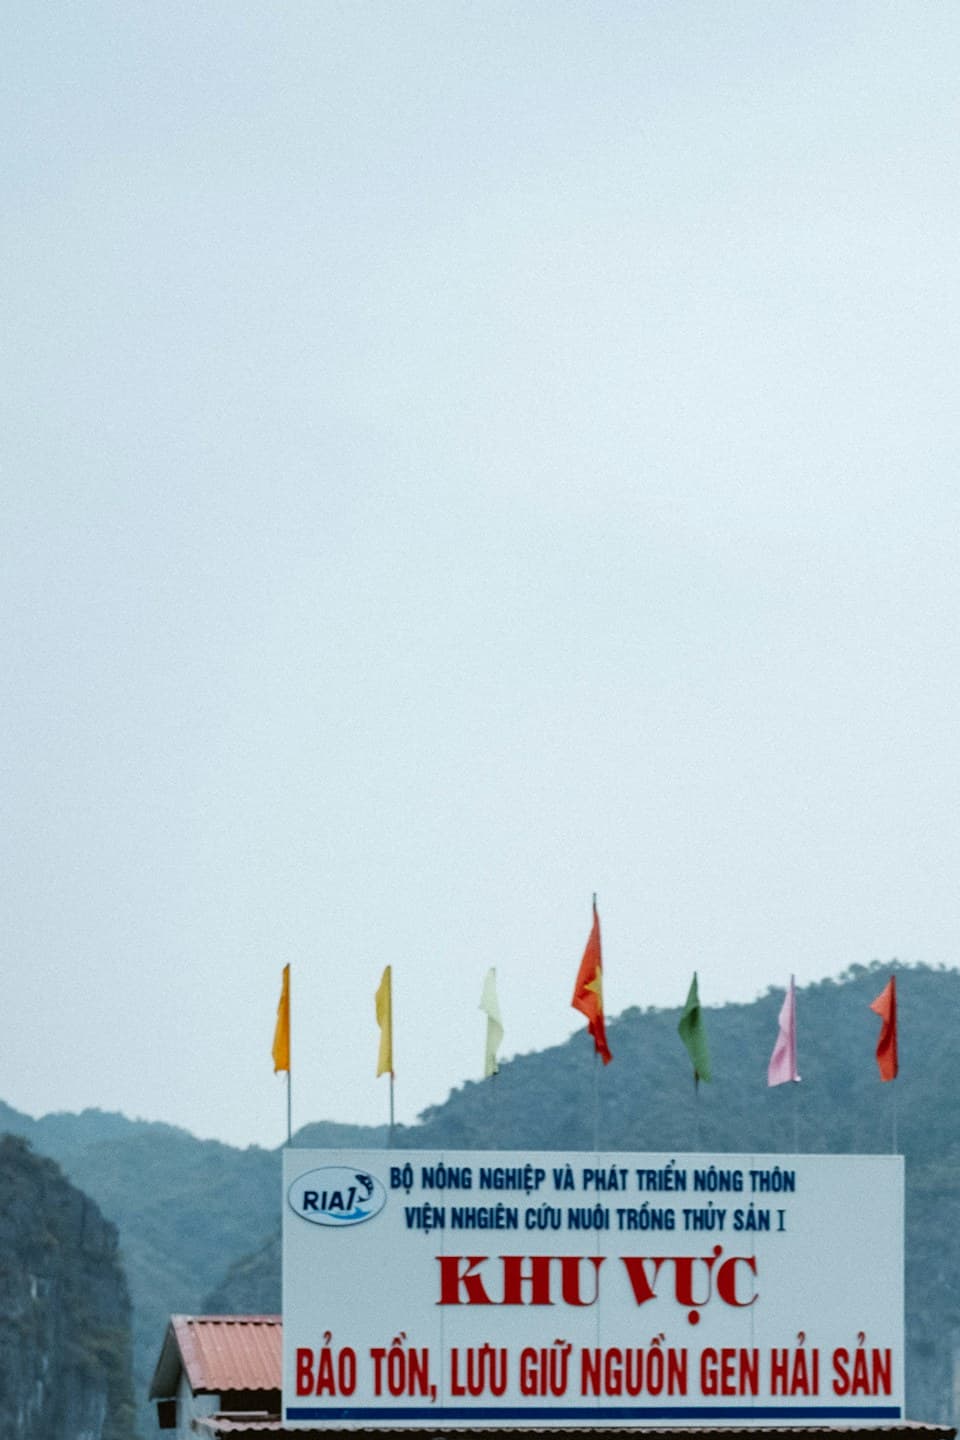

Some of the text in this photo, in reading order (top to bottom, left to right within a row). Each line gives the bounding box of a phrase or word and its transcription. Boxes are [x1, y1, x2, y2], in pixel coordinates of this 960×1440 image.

[390, 1159, 795, 1195] BỘ NÔNG NGHIỆP VÀ PHÁT TRIỂN NÔNG THÔN
[303, 1187, 357, 1211] RIA1
[405, 1202, 445, 1234] VIỆN
[451, 1202, 518, 1230] NHGIÊN
[525, 1202, 562, 1231] CỨU
[568, 1203, 609, 1231] NUÔI
[683, 1200, 726, 1231] THỦY
[733, 1202, 770, 1231] SẢN
[777, 1209, 786, 1231] I
[435, 1245, 760, 1325] KHU VỰC
[296, 1330, 892, 1403] BẢO TỒN, LƯU GIỮ NGUỒN GEN HẢI SẢN
